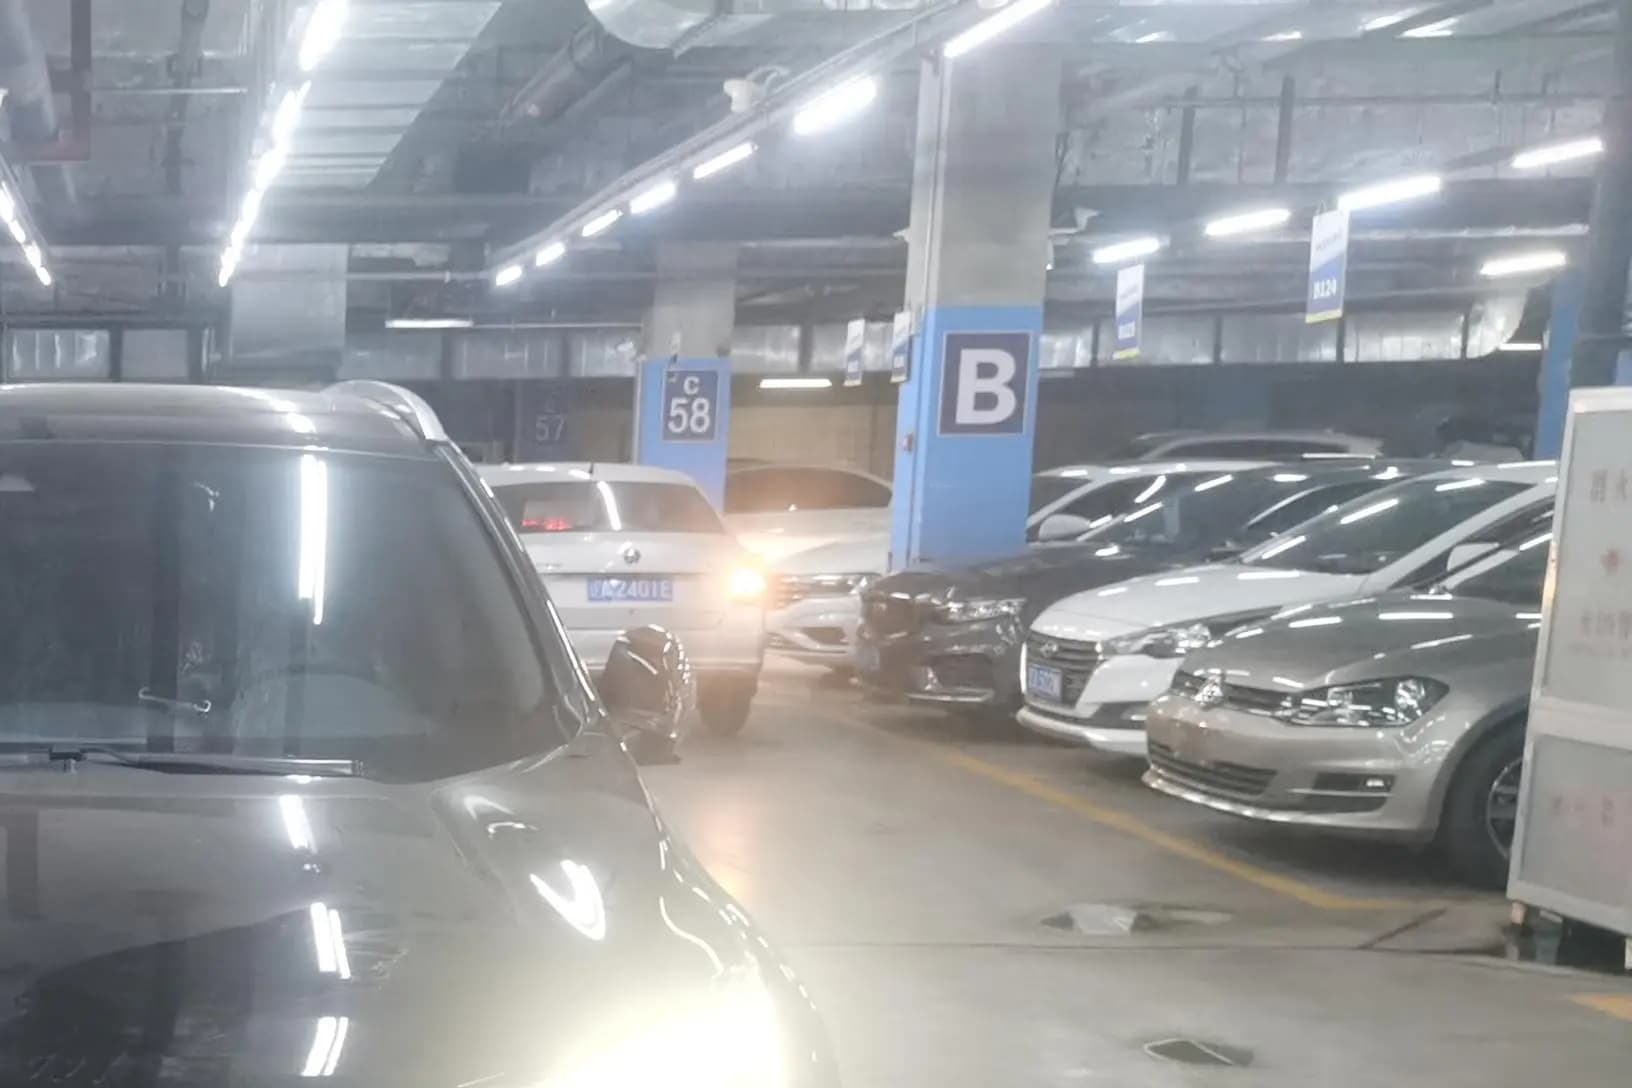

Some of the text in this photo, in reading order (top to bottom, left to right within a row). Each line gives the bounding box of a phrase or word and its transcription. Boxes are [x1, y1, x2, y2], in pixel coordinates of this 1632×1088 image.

[683, 376, 700, 395] C
[954, 348, 1018, 426] B
[536, 415, 566, 441] 57
[668, 398, 710, 433] 58
